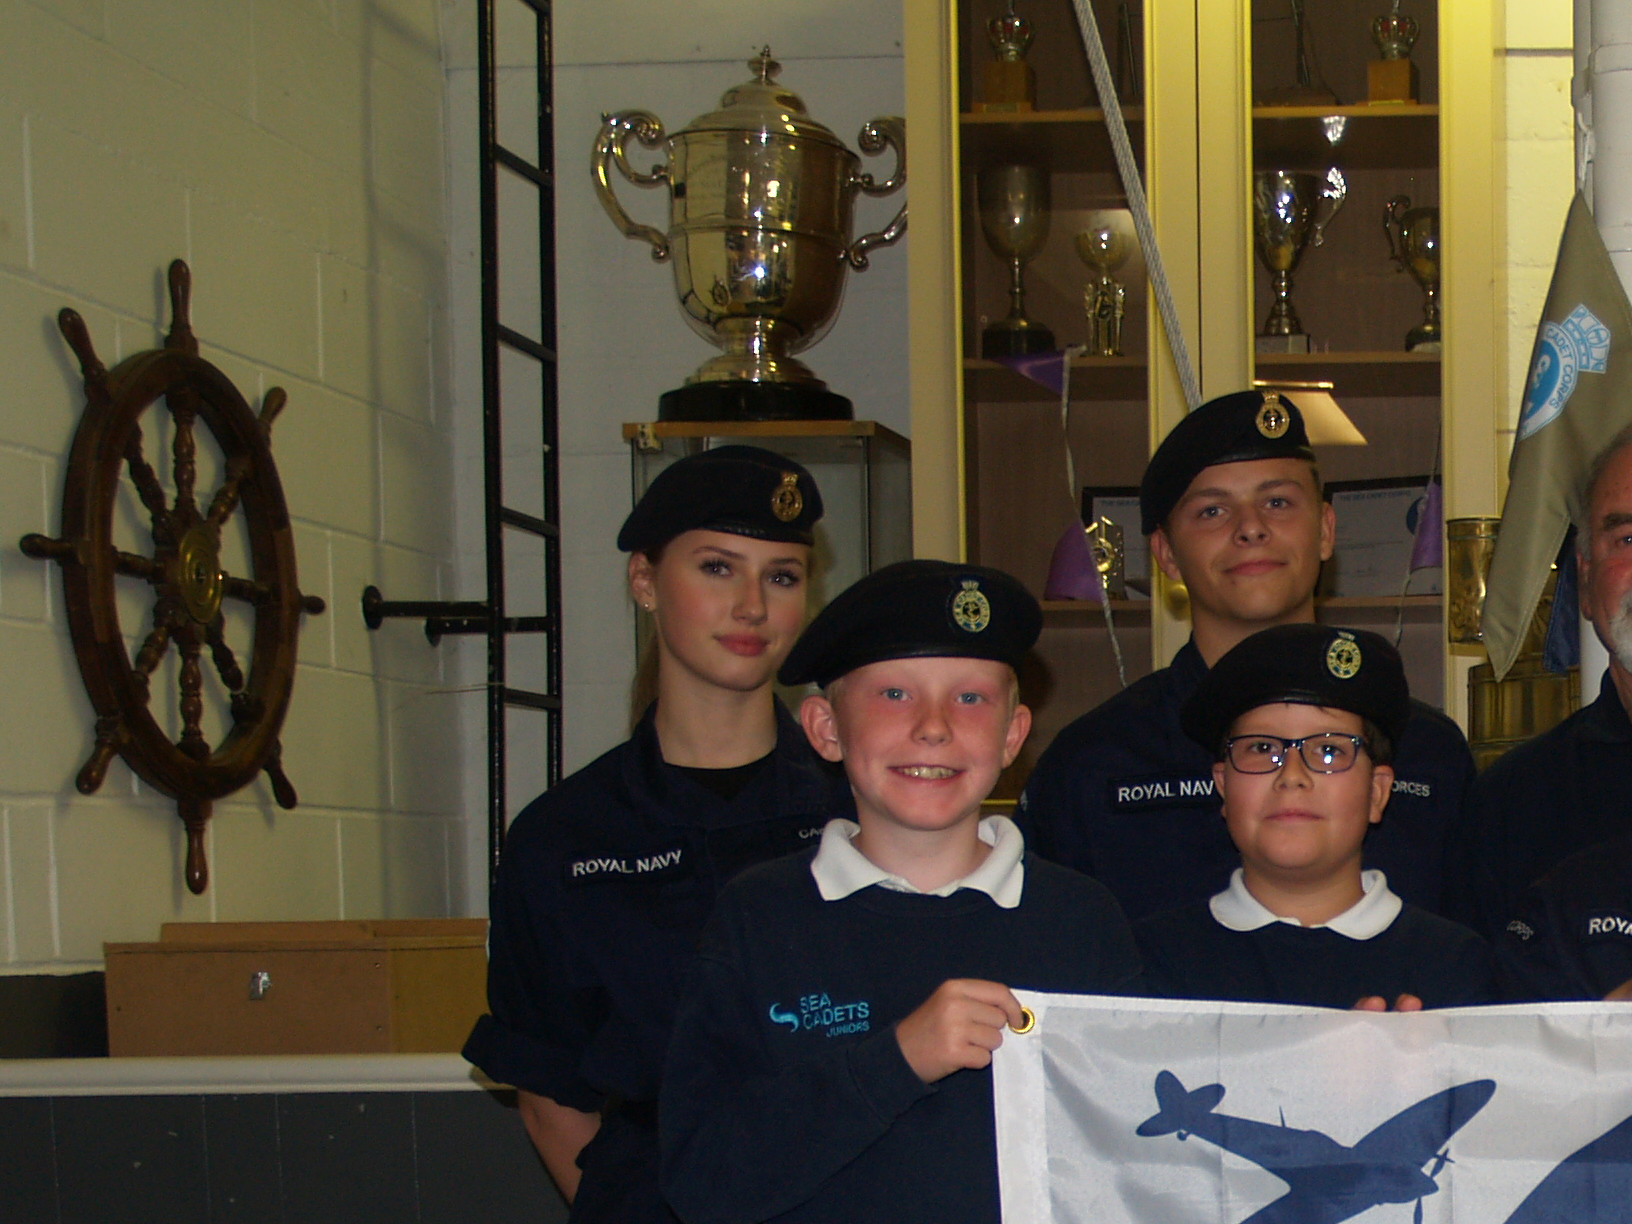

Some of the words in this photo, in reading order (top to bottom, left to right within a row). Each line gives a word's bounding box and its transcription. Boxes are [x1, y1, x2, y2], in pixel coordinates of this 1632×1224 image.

[1549, 363, 1575, 409] CORPS
[1118, 782, 1176, 803] ROYAL
[1180, 779, 1215, 797] NAV
[1391, 780, 1431, 797] ORCES
[573, 857, 635, 878] ROYAL
[637, 849, 682, 873] NAVY
[800, 991, 832, 1014] SEA
[802, 1001, 871, 1030] CADETS
[826, 1020, 872, 1038] JUNIORS
